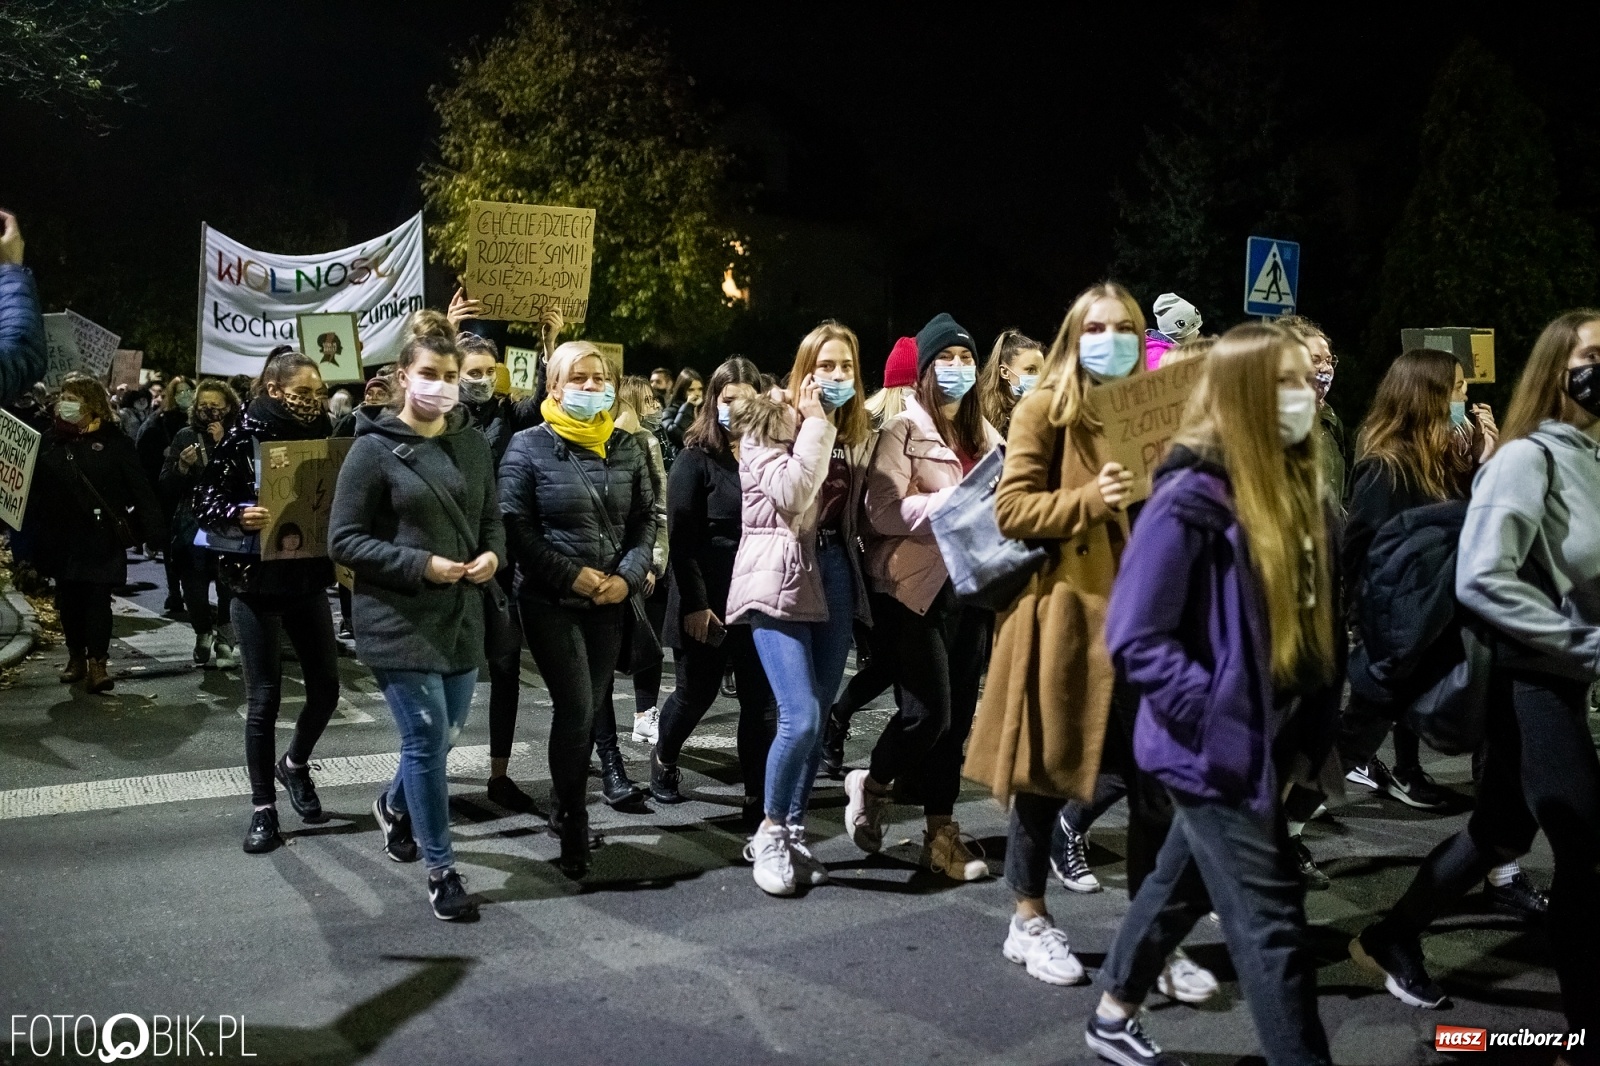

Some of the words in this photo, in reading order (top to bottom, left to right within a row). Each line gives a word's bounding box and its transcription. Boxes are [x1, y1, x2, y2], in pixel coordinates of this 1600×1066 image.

[477, 210, 537, 236] CHCECIE
[541, 212, 592, 239] DZIECI?
[216, 236, 395, 293] WOLNOŚĆ
[213, 301, 296, 340] kocha
[511, 295, 526, 316] Z
